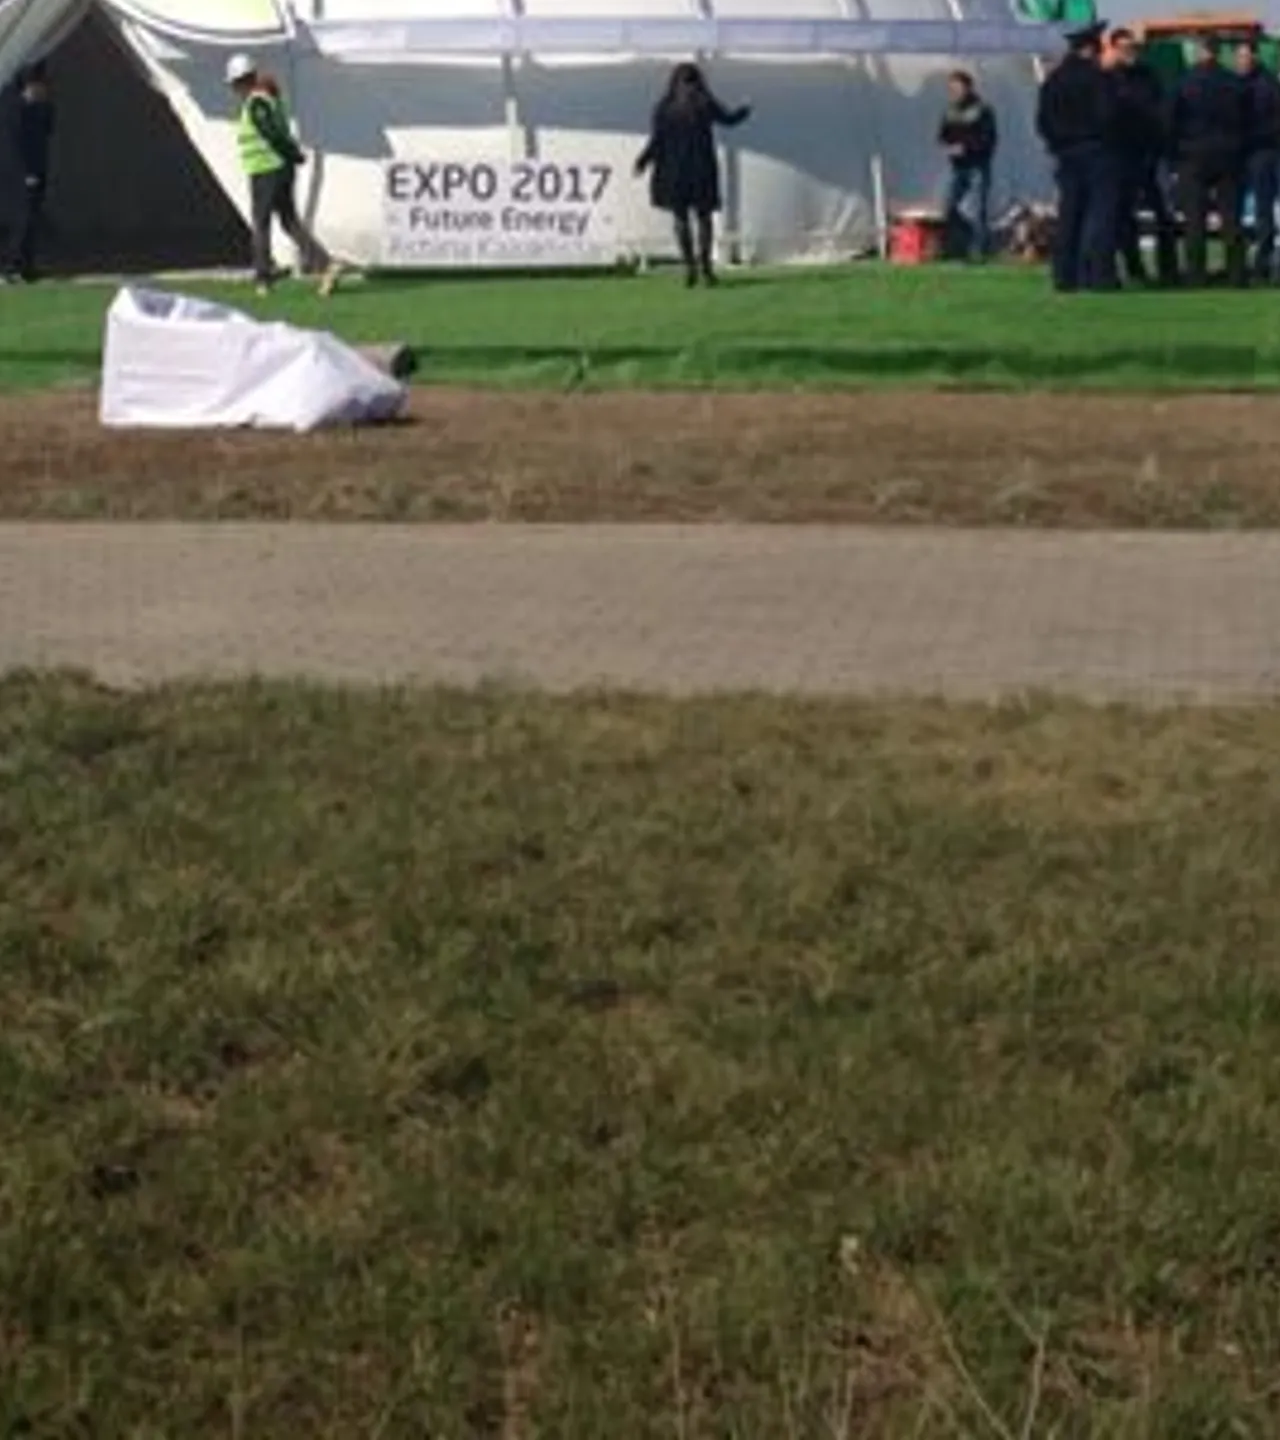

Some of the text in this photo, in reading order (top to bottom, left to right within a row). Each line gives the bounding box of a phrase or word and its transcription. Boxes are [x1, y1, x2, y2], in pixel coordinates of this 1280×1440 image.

[387, 163, 613, 202] EXPO 2017
[409, 207, 591, 236] Future Energy
